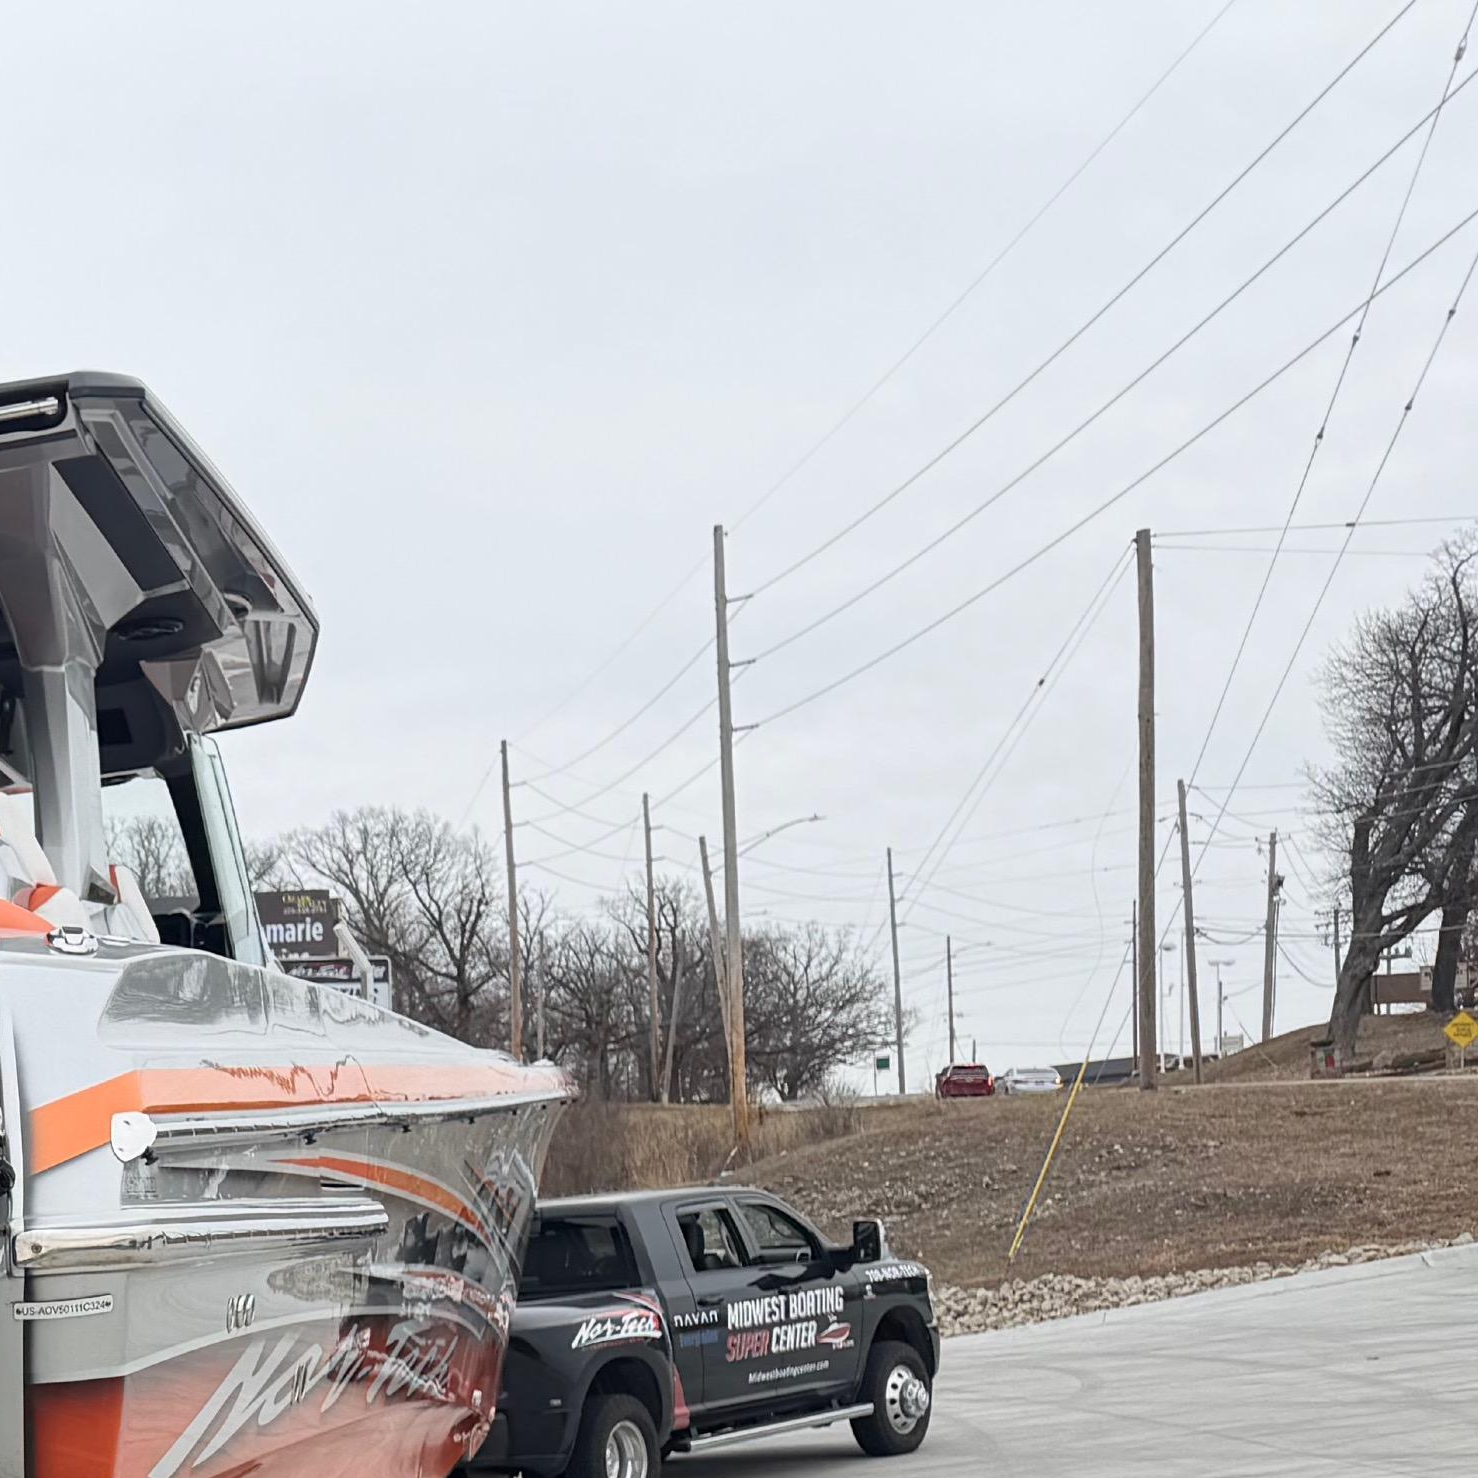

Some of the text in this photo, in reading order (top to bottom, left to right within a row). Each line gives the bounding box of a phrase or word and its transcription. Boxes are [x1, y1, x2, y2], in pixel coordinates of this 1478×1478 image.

[262, 916, 324, 944] marie
[727, 1286, 845, 1330] MIDWEST BOATING
[571, 1311, 662, 1350] Nor-Tech
[726, 1329, 770, 1362] SUPER
[771, 1320, 818, 1354] CENTER
